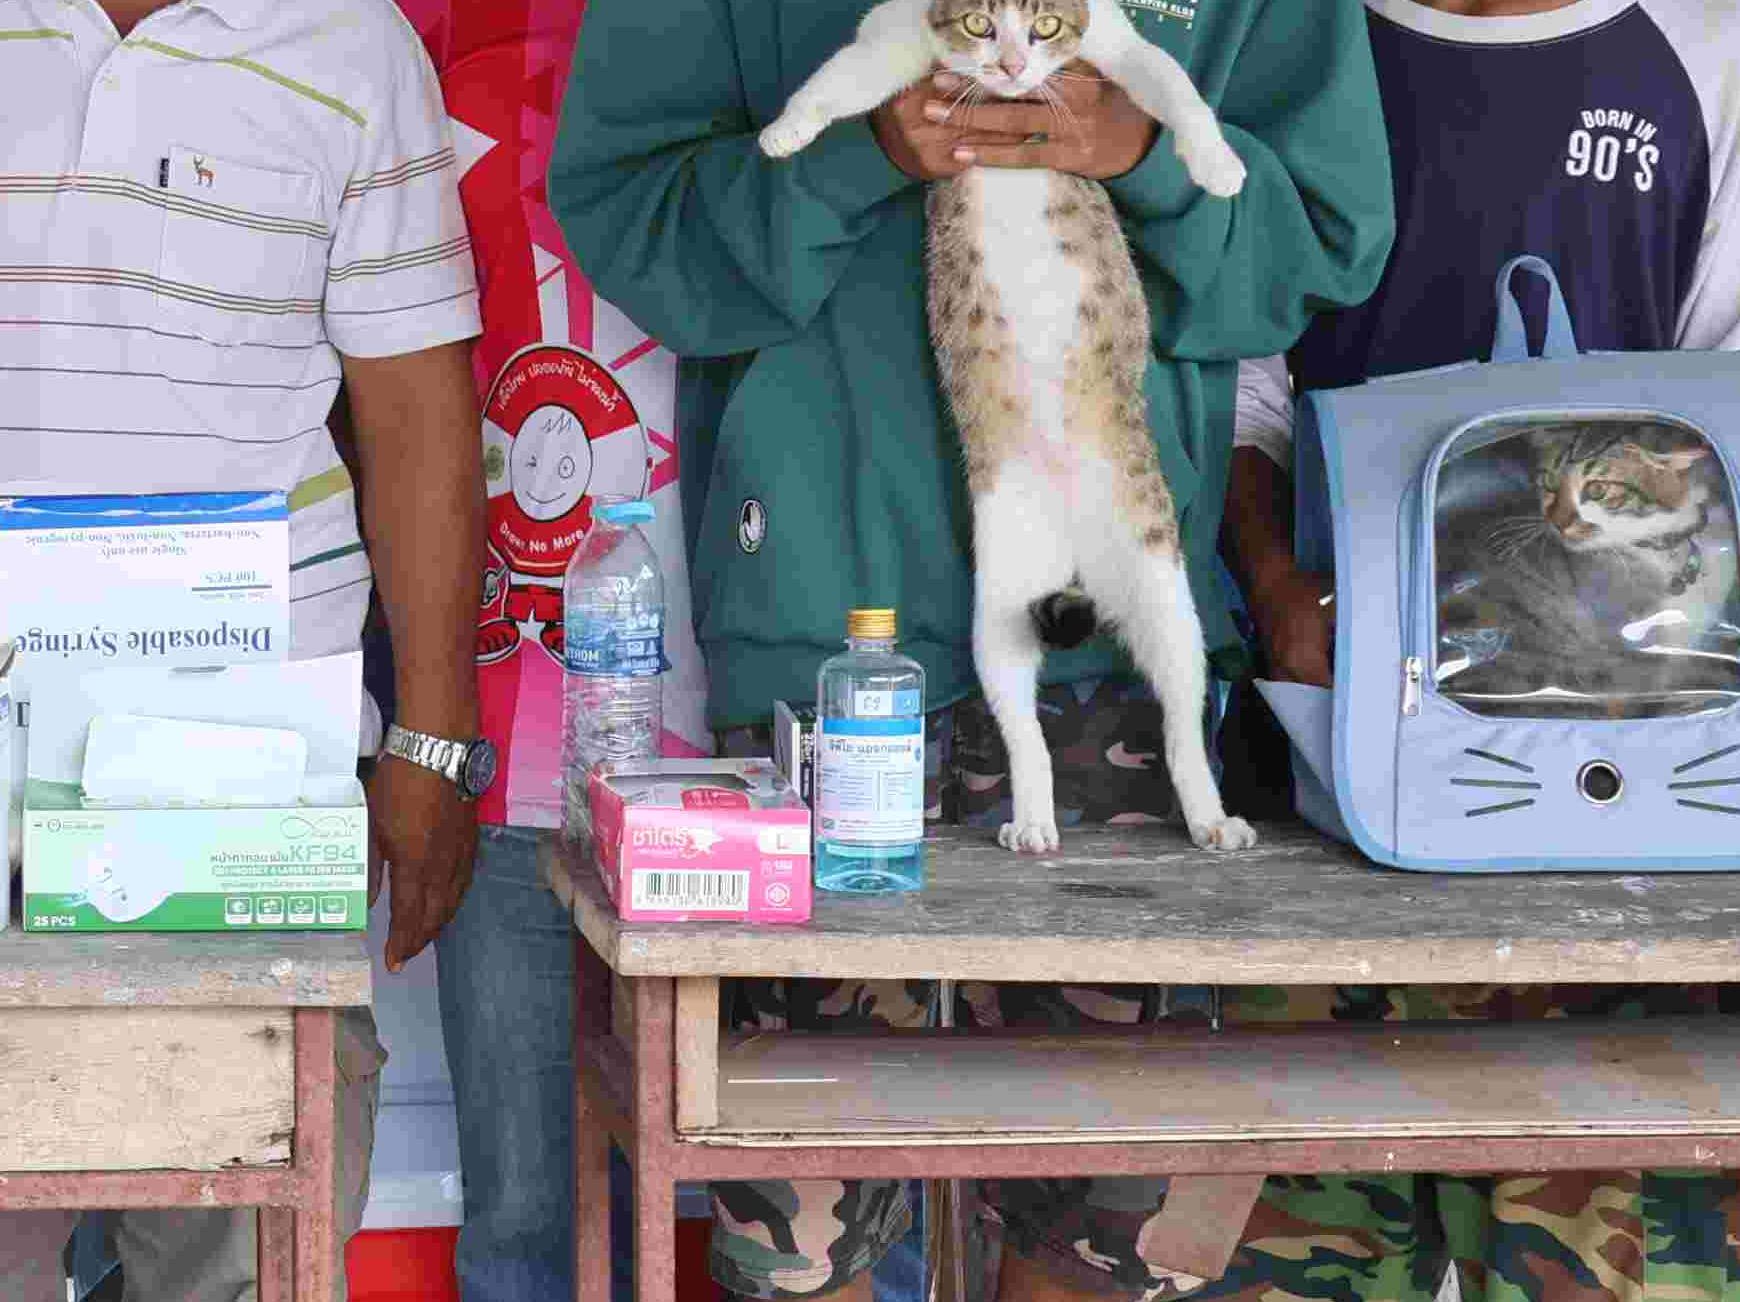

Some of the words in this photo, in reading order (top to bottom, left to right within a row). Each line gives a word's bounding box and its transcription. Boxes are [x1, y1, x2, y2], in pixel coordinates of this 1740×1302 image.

[1580, 108, 1635, 131] BORN
[1633, 118, 1658, 142] IN
[1565, 129, 1660, 193] 90'S
[15, 625, 120, 659] Syringe
[125, 621, 273, 656] Disposable
